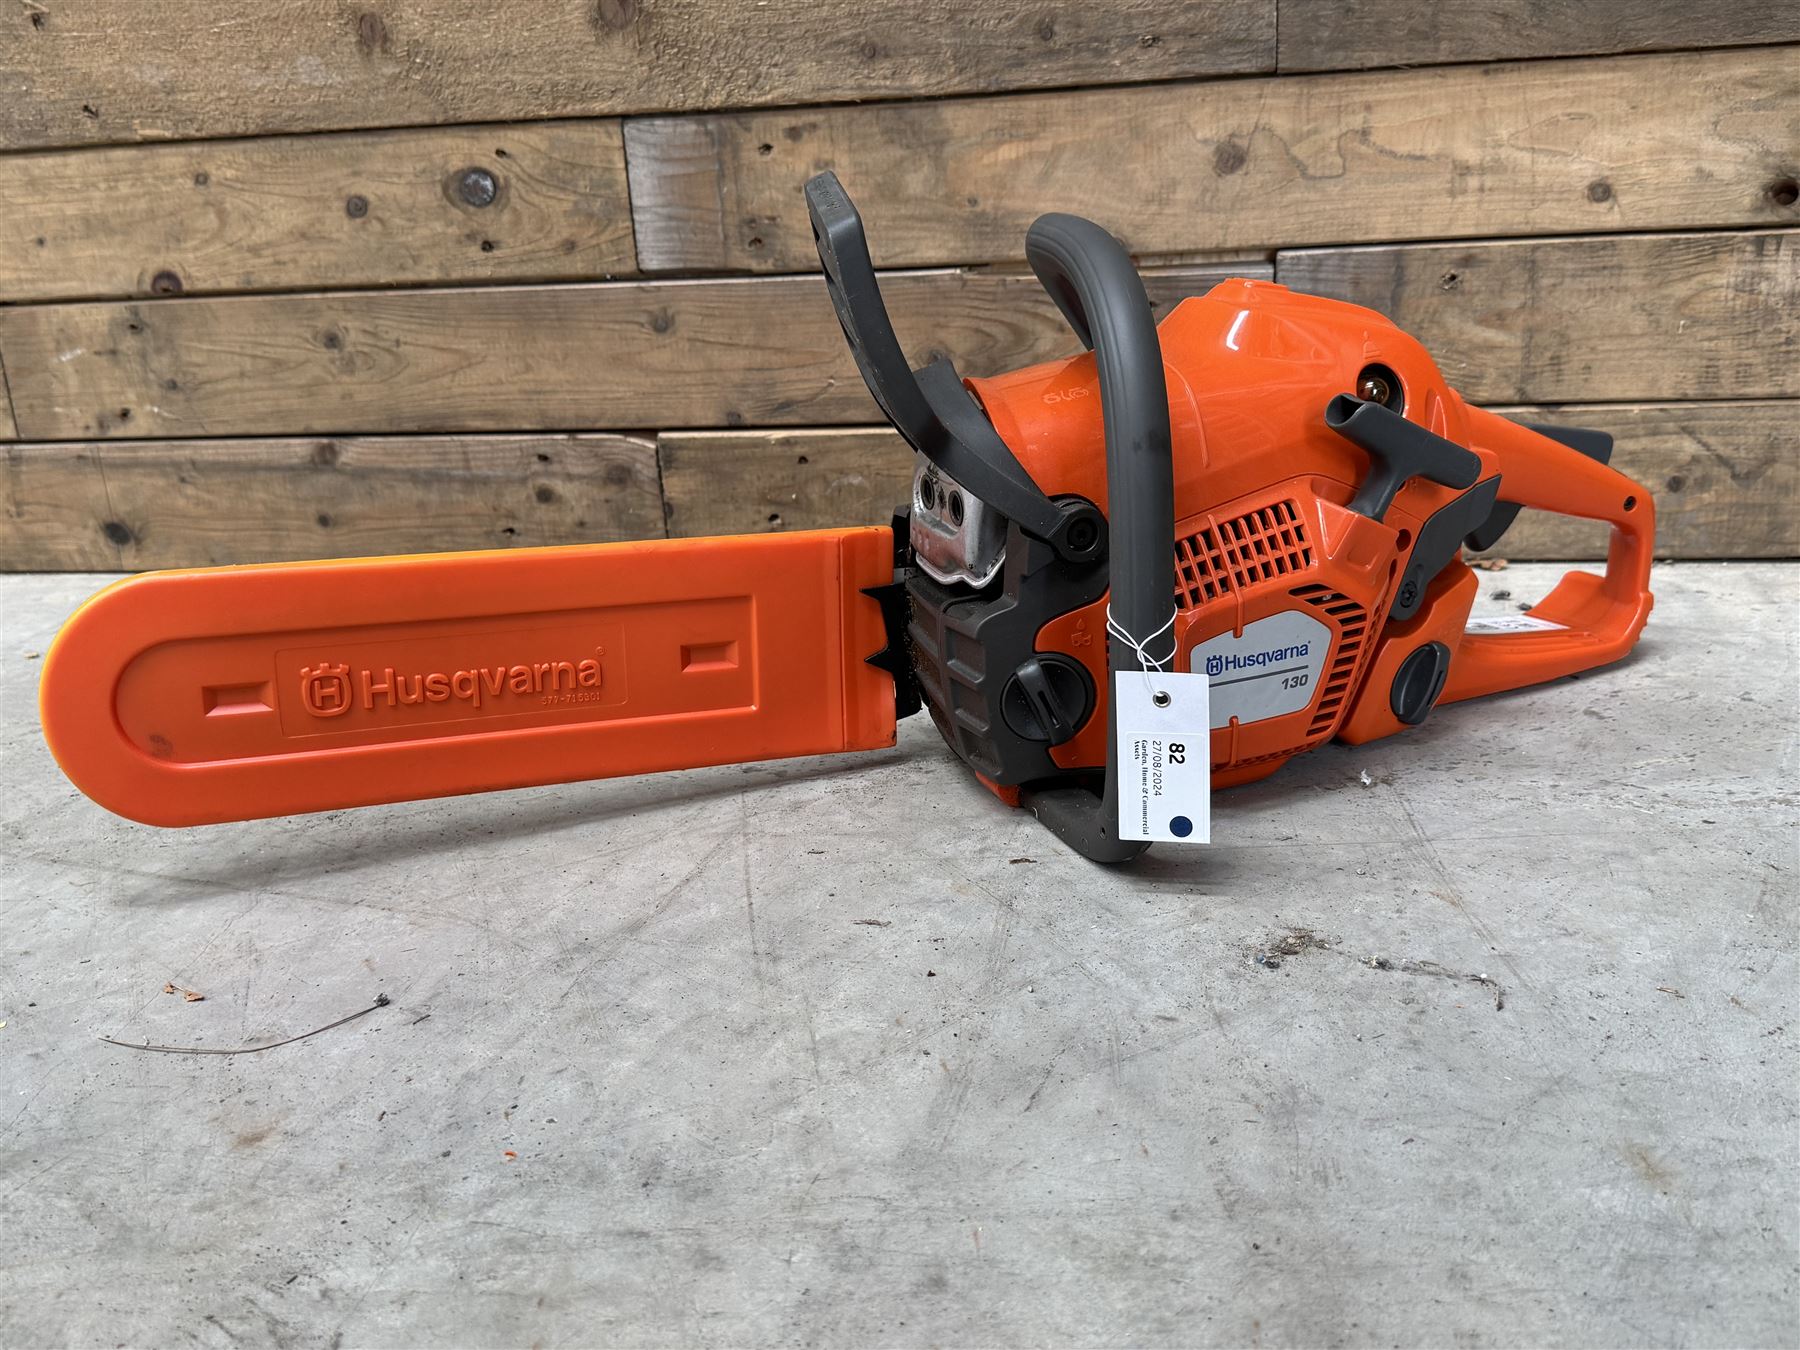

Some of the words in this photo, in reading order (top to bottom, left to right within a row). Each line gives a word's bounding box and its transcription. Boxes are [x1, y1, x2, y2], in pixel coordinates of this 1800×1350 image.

[1225, 643, 1309, 671] Husqvarna
[361, 658, 602, 709] Husqvarna
[1281, 674, 1309, 690] 130
[1141, 739, 1149, 766] Garden,
[1169, 742, 1186, 765] 82
[1152, 740, 1162, 797] 27/08/2024
[1142, 787, 1149, 795] &
[1142, 795, 1150, 835] Commercial
